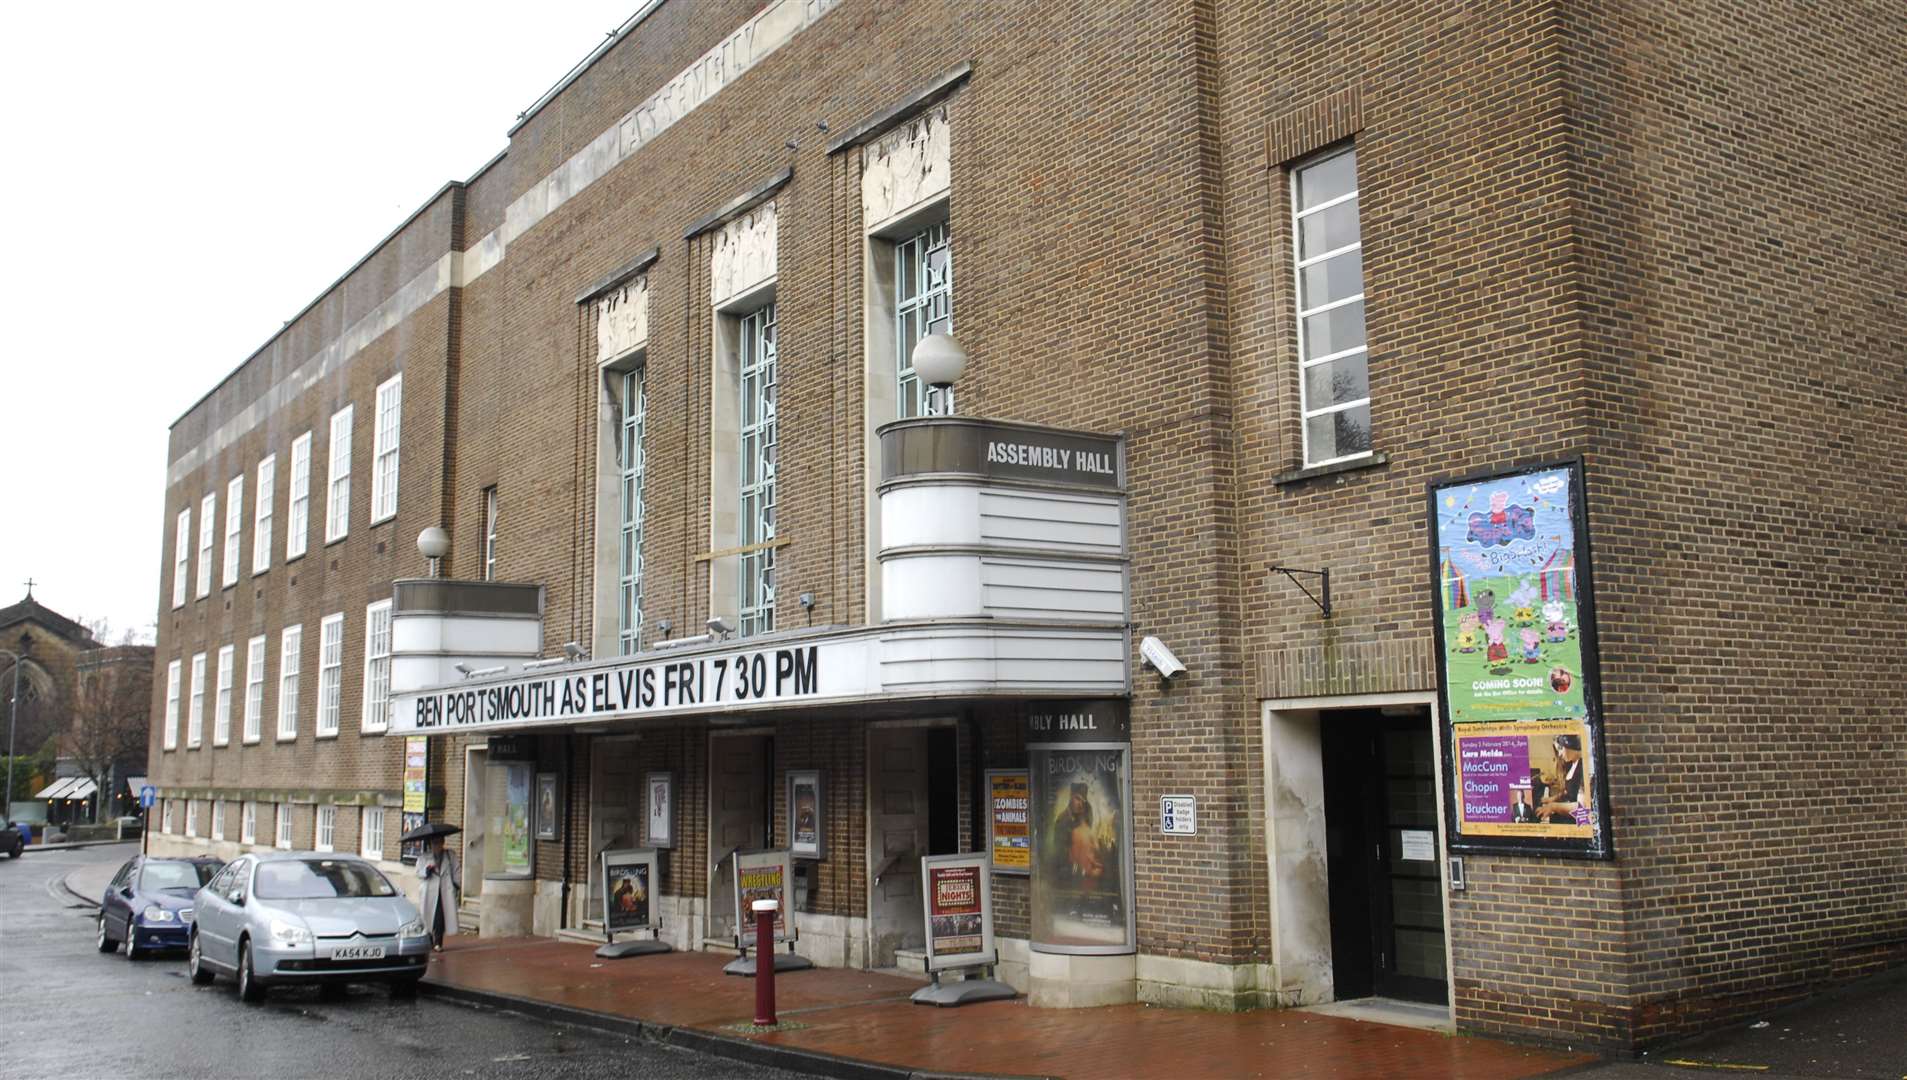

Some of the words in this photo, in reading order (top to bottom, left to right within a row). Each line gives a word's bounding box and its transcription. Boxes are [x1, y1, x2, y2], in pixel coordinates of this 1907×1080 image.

[987, 441, 1070, 469] ASSEMBLY
[1075, 451, 1114, 474] HALL
[416, 695, 442, 728] BEN
[446, 679, 554, 725] PORTSMOUTH
[560, 676, 587, 715] AS
[592, 668, 656, 713] ELVIS
[664, 660, 705, 706] FRI
[714, 659, 728, 702] 7
[735, 653, 767, 700] 30
[776, 646, 818, 697] PM
[1472, 680, 1510, 690] COMING
[1059, 714, 1097, 730] HALL
[1463, 761, 1509, 772] MacCunn
[1465, 780, 1499, 794] Chopin
[996, 798, 1027, 810] ZOMBIES
[1466, 802, 1507, 814] Bruckner
[1001, 812, 1026, 823] ANIMALS
[942, 890, 972, 902] NIGHTS
[335, 948, 360, 958] KA54
